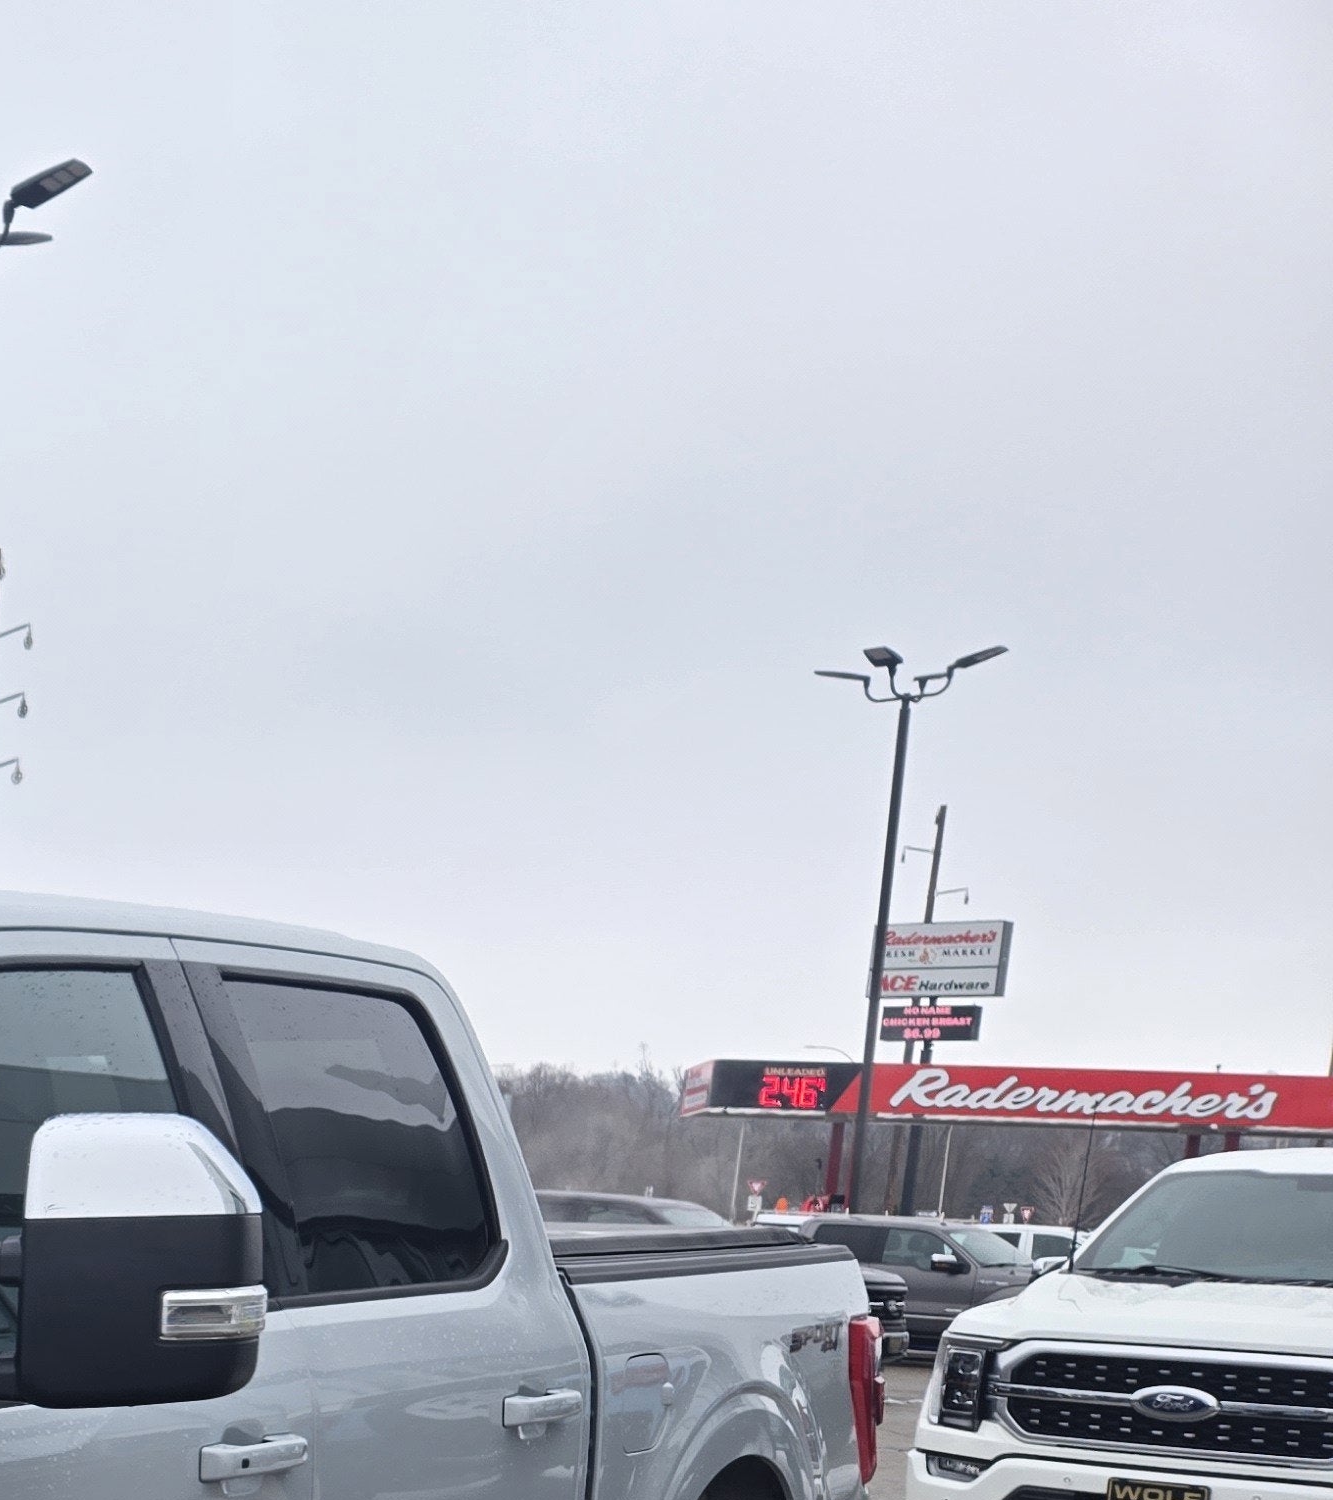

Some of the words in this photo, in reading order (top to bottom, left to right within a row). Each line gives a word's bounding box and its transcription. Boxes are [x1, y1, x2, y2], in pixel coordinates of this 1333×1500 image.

[942, 948, 992, 957] MARKET
[918, 979, 990, 991] Hardware
[904, 1006, 919, 1015] NO
[920, 1006, 951, 1015] NAME
[883, 1018, 930, 1026] CHICKEN
[931, 1017, 972, 1026] BREAST
[764, 1067, 826, 1077] UNLEADED
[890, 1068, 1278, 1119] Radermacher's
